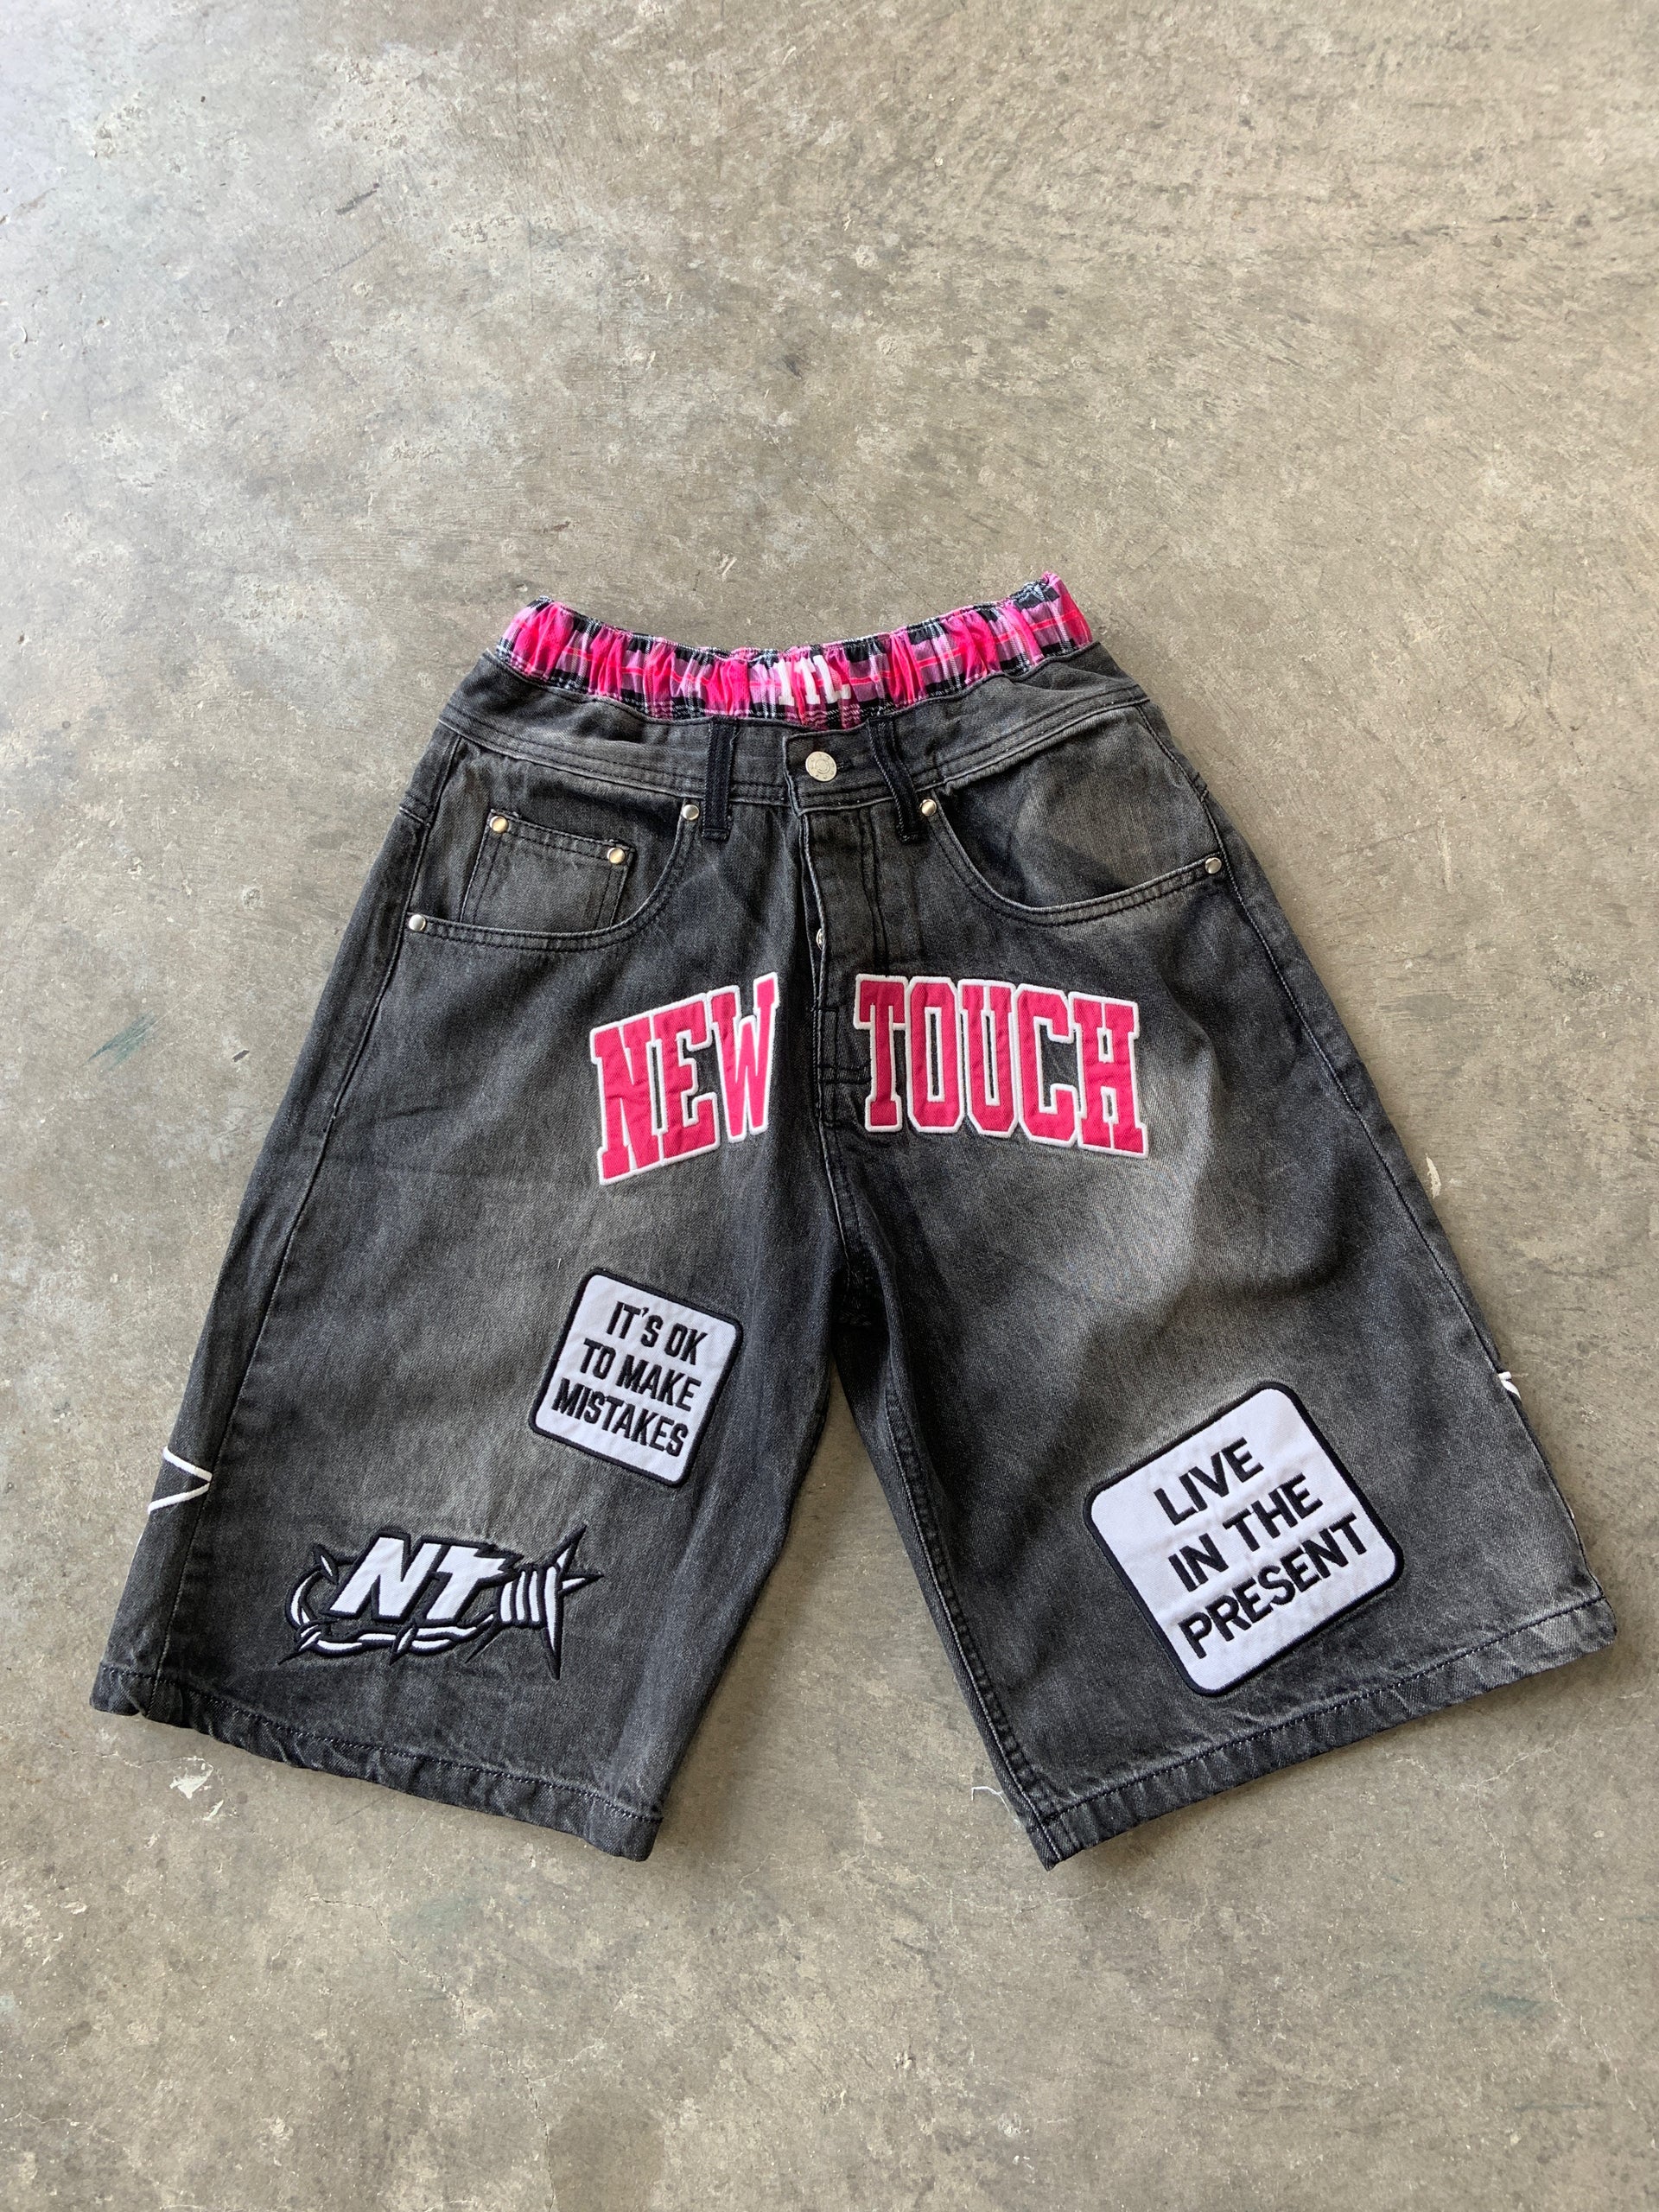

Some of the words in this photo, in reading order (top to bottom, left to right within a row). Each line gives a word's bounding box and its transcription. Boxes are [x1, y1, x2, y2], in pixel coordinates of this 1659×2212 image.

[590, 972, 779, 1185] NEW
[854, 974, 1148, 1159] TOUCH
[580, 1338, 617, 1380] TO
[615, 1354, 702, 1412] MAKE
[607, 1301, 664, 1348] IT'S
[664, 1323, 708, 1365] OK
[551, 1377, 689, 1458] MISTAKES
[1154, 1437, 1264, 1526] LIVE
[324, 1529, 518, 1624] NT
[1168, 1533, 1229, 1592] IN
[1223, 1472, 1323, 1552] THE
[1178, 1512, 1367, 1659] PRESENT
